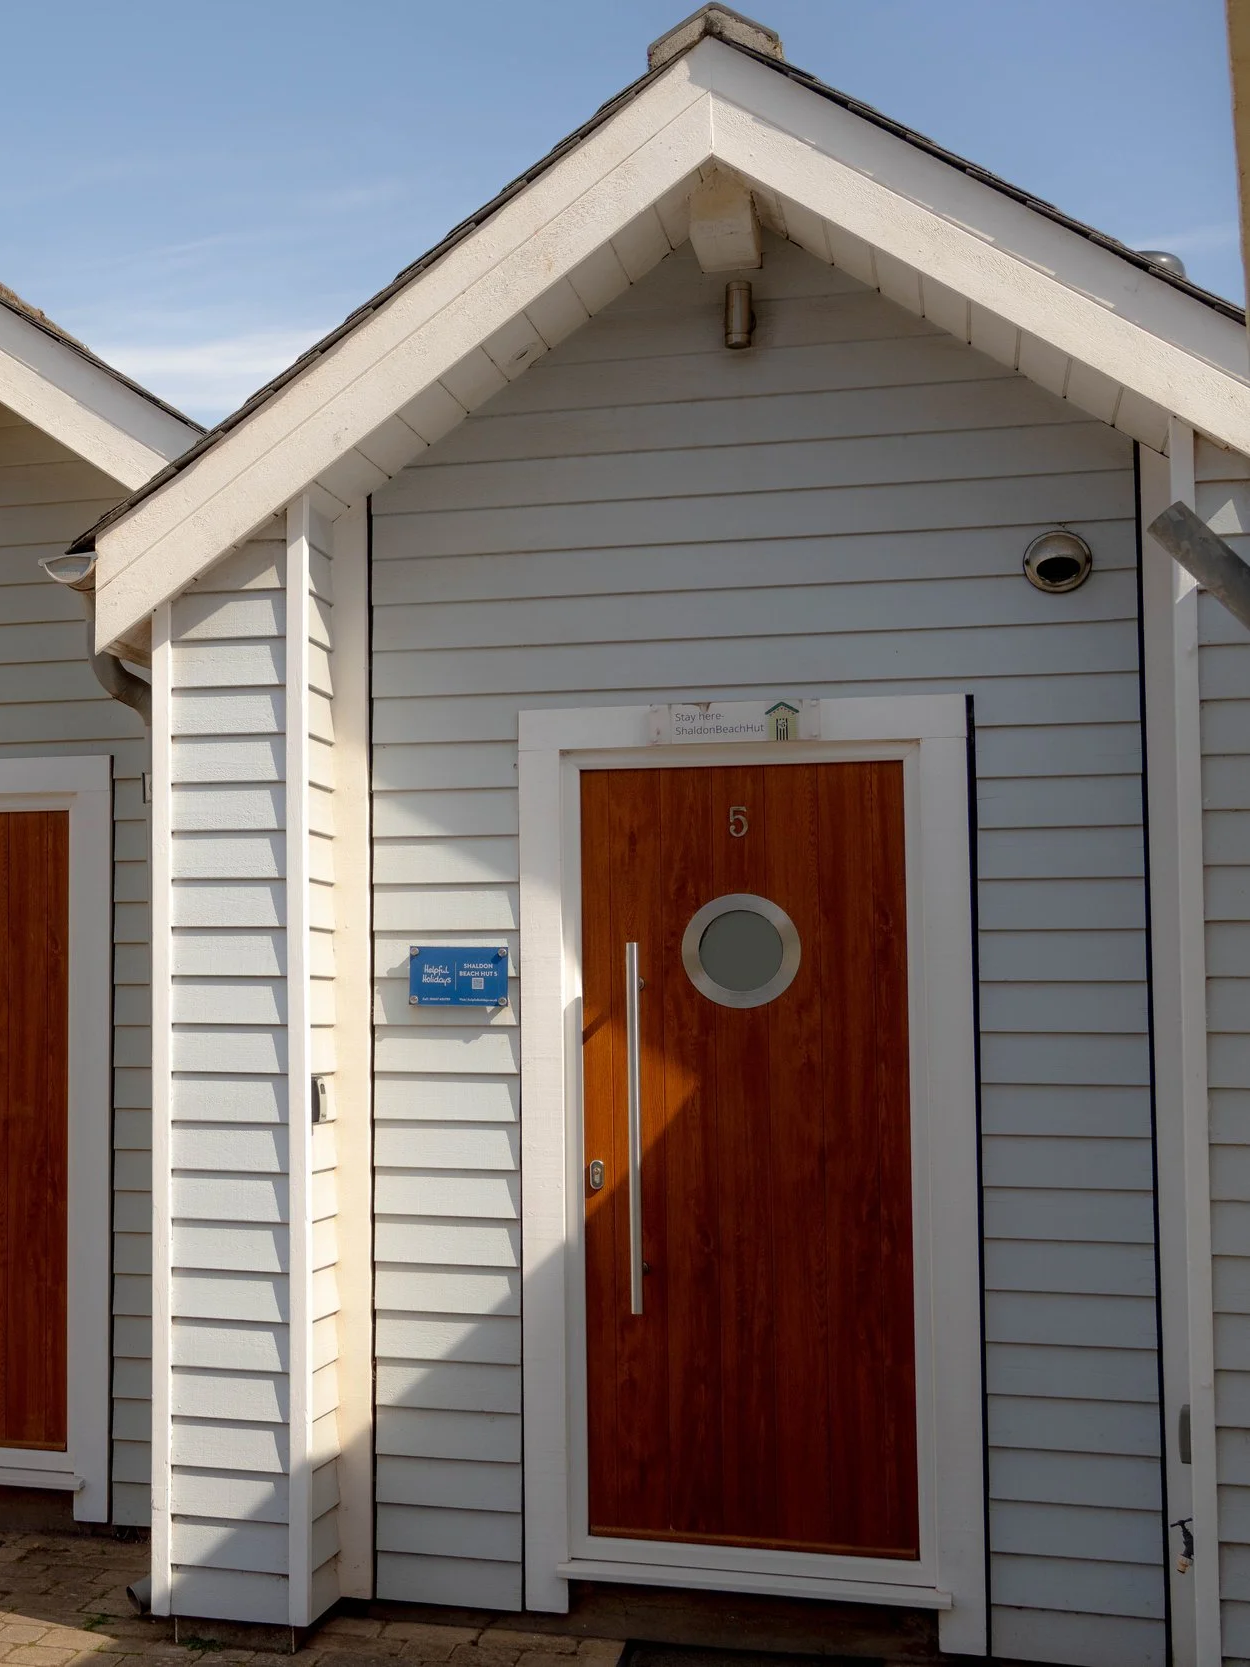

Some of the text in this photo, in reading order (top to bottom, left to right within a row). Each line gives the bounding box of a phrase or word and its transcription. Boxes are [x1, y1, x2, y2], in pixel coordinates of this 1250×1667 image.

[675, 713, 696, 723] Stay
[676, 724, 764, 736] ShaldonBeachHut
[729, 806, 749, 837] 5
[424, 964, 449, 975] Helpful
[422, 974, 451, 986] Holidays
